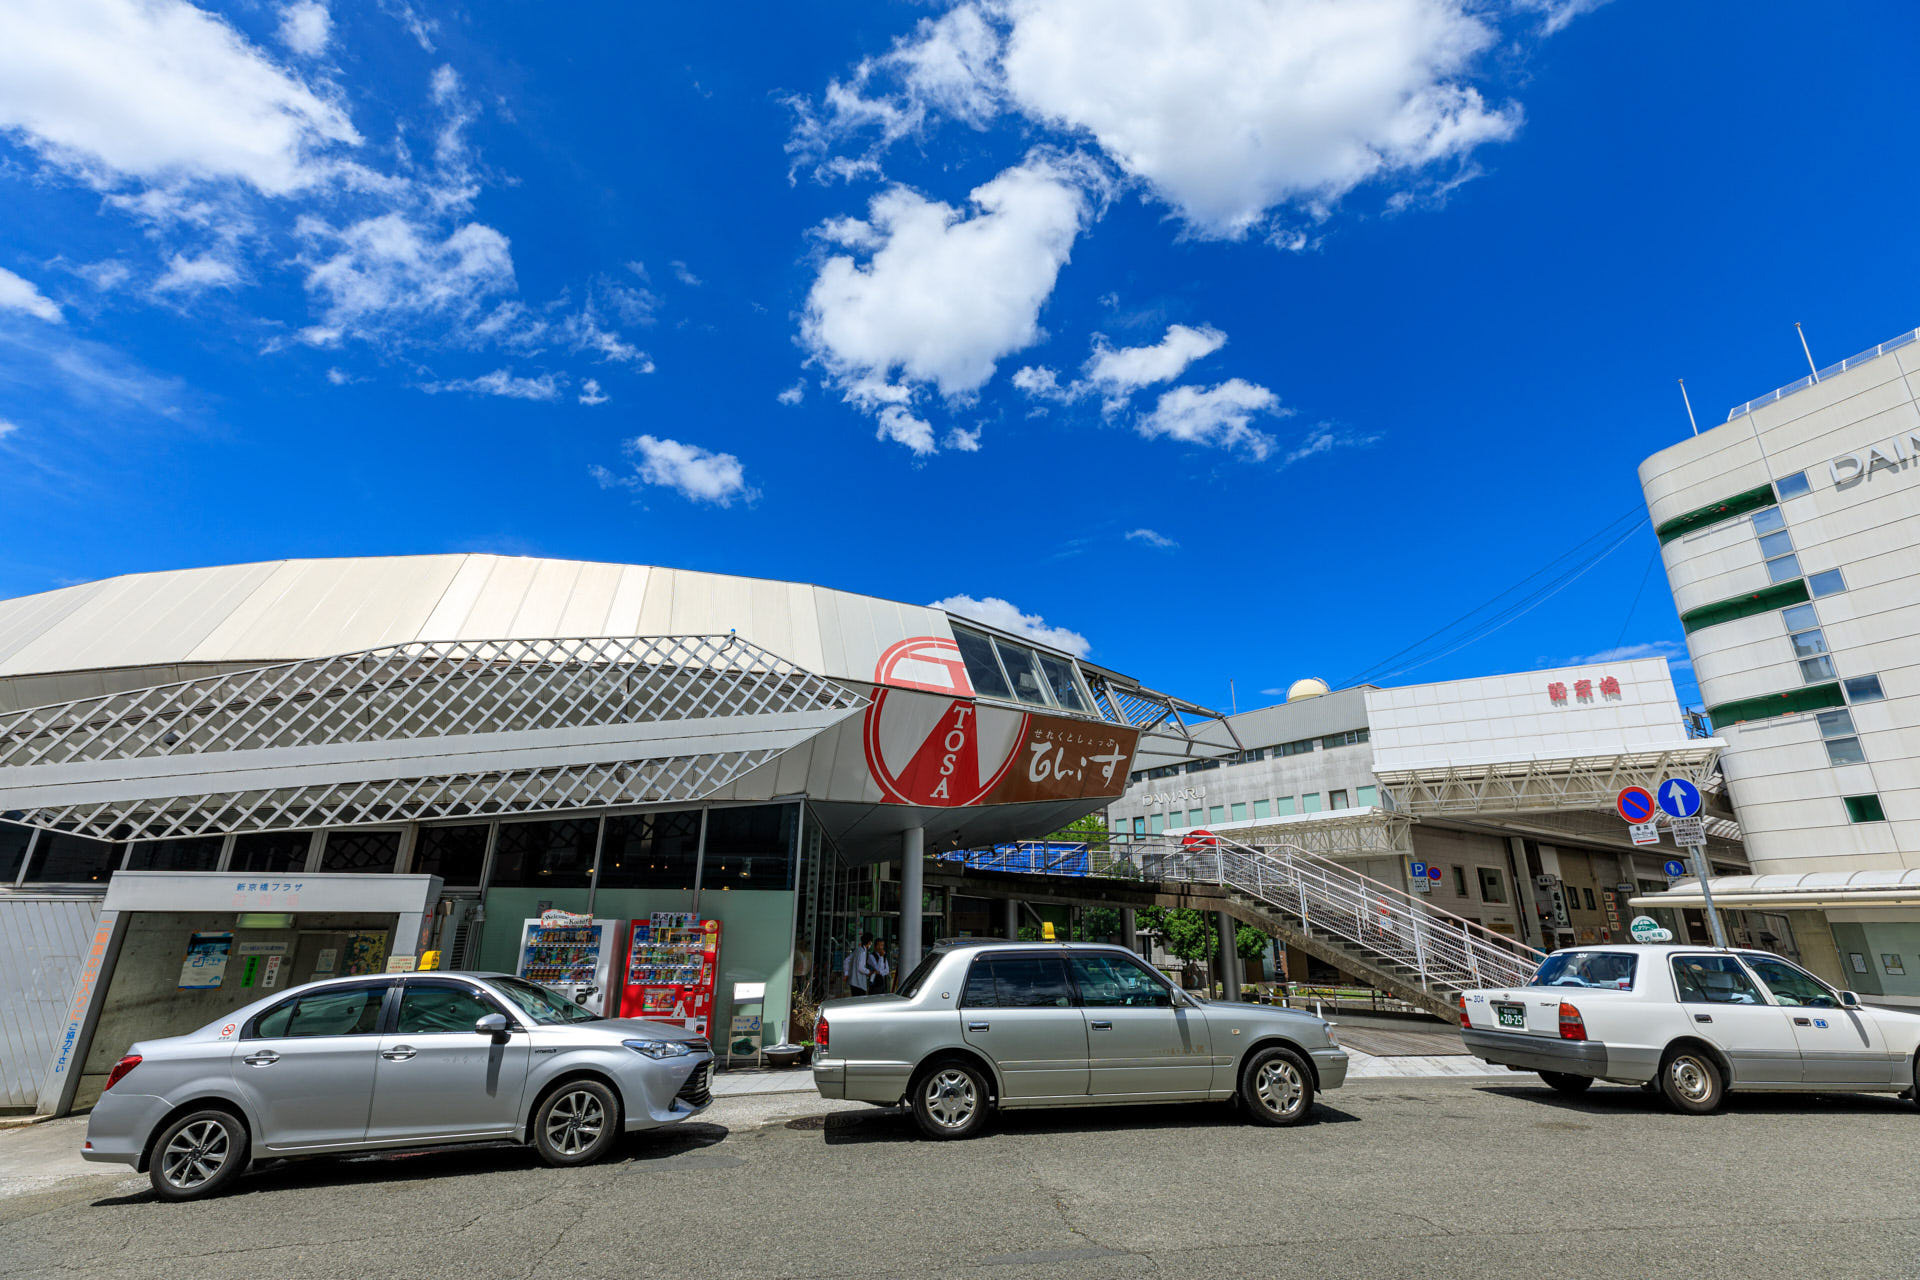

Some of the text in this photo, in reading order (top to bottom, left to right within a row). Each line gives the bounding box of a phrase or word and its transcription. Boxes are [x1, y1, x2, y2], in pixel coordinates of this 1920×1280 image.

[1547, 675, 1621, 702] 新京橋
[1034, 729, 1116, 748] せれくとしょっぷ
[929, 705, 972, 799] TOSA
[1142, 785, 1208, 807] DAIMARU
[1473, 994, 1484, 1003] 304
